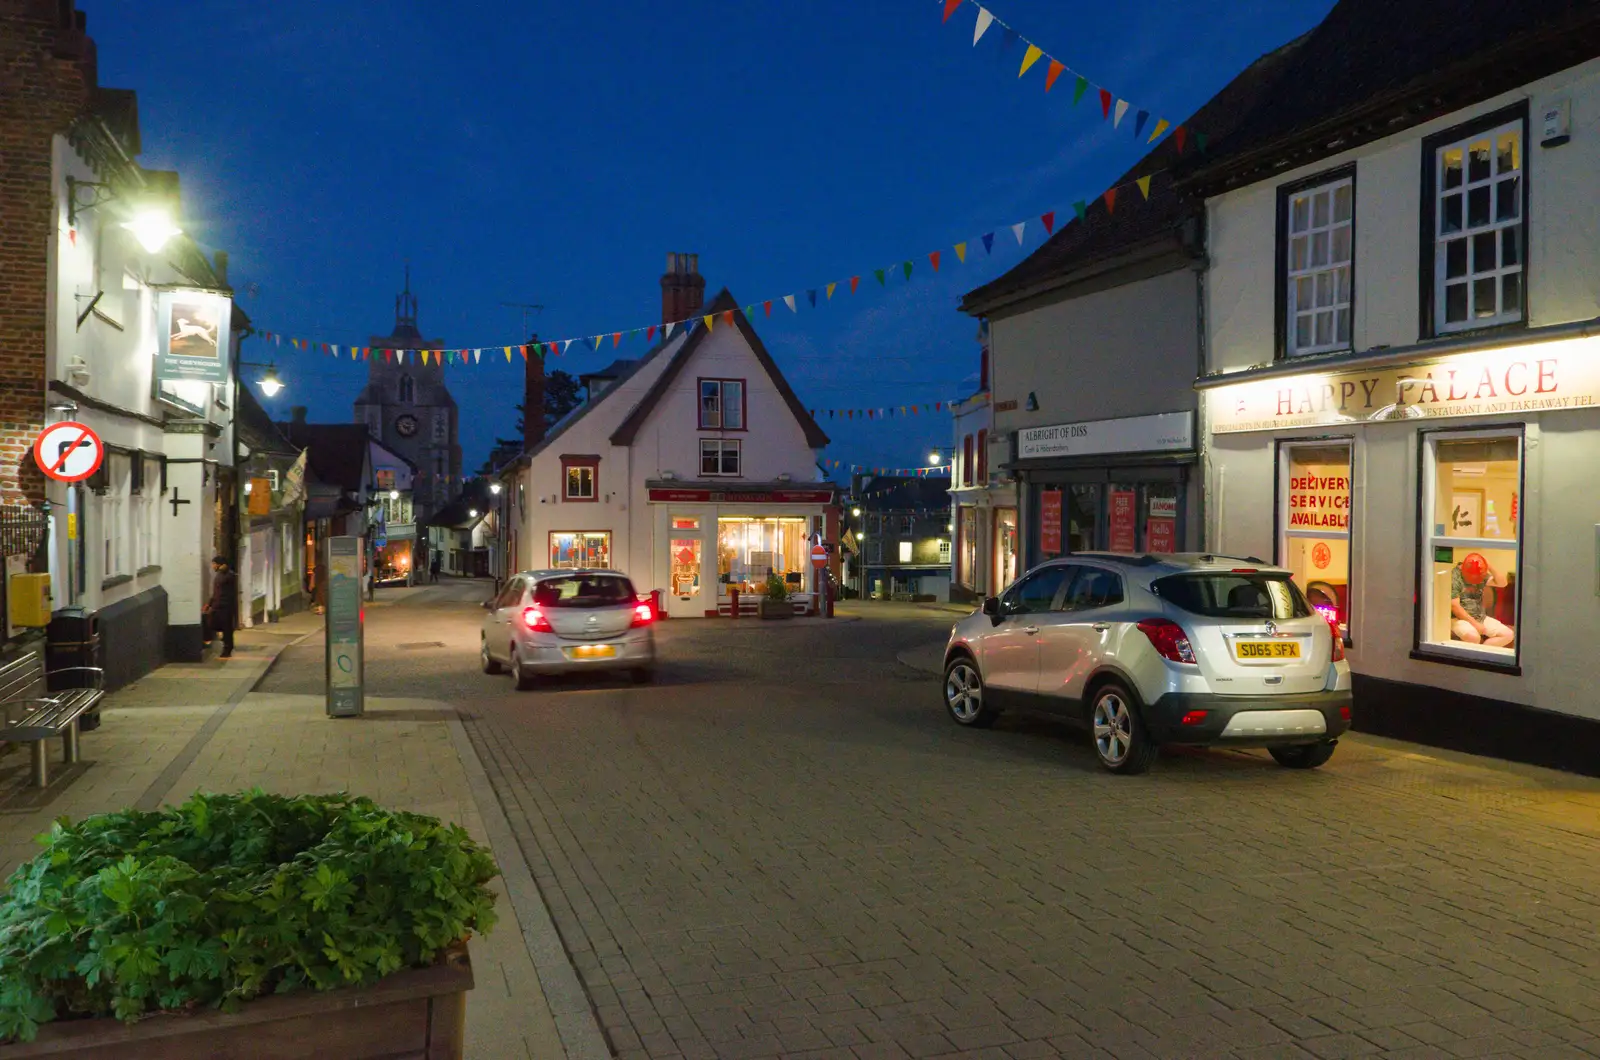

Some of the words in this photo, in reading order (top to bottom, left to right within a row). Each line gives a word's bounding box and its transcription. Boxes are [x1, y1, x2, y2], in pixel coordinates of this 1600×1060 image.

[180, 359, 222, 367] GREYHOUND
[1275, 378, 1380, 416] HAPPY
[1396, 358, 1559, 406] PALACE
[1485, 402, 1507, 414] AND
[1510, 397, 1570, 411] TAKEAWAY
[1026, 428, 1059, 441] ALBRIGHT
[1060, 427, 1070, 439] OF
[1071, 425, 1088, 438] DISS
[1290, 477, 1350, 490] DELIVERY
[1152, 501, 1176, 511] JANOM
[1290, 494, 1350, 509] SERVICE
[1241, 643, 1272, 657] SD65
[1273, 643, 1297, 657] SFX
